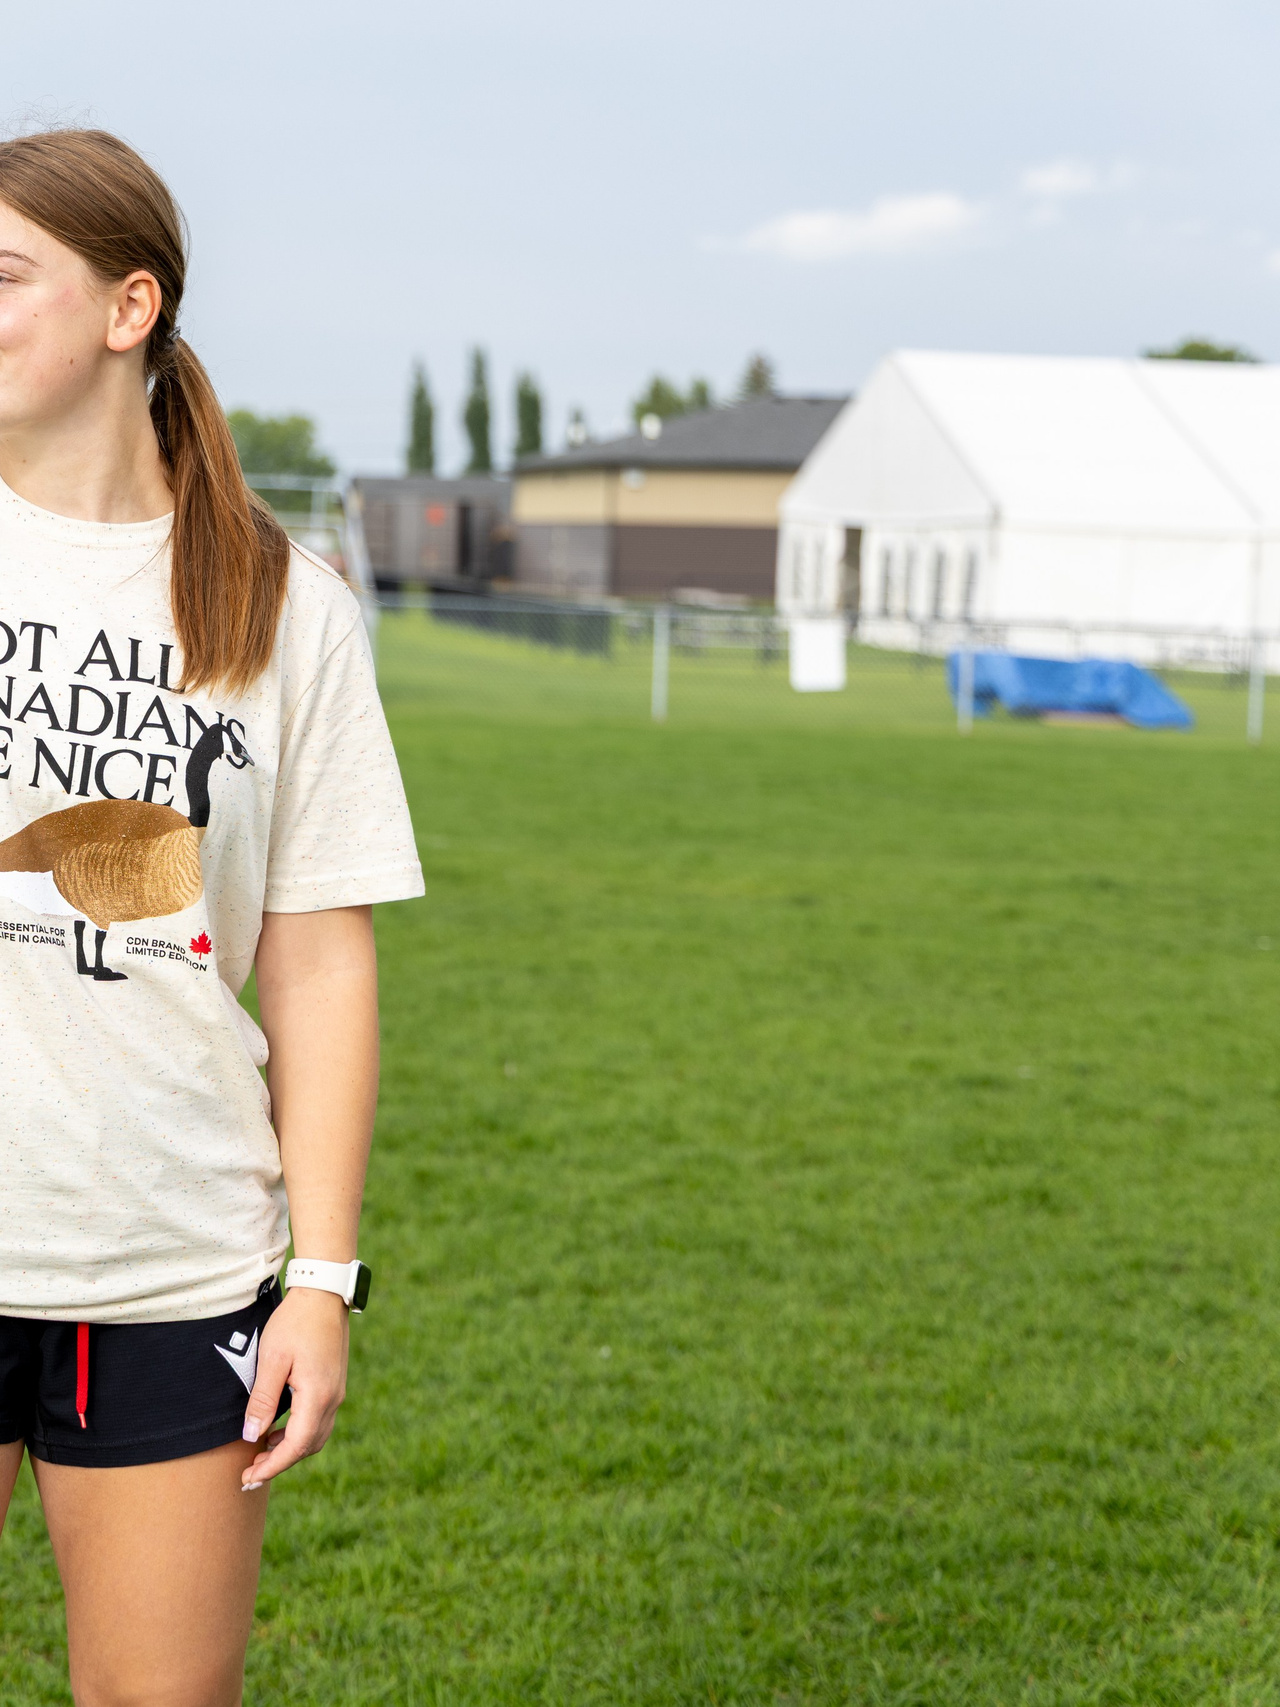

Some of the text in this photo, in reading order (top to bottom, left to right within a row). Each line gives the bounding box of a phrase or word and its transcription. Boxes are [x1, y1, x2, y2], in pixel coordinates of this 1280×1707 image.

[74, 628, 187, 695] ALL
[28, 736, 178, 808] NICE
[18, 934, 30, 943] IN
[32, 934, 66, 948] CANADA
[49, 926, 66, 938] FOR
[126, 936, 186, 955] CDN BRAND
[126, 946, 208, 972] LIMITED EDITION
